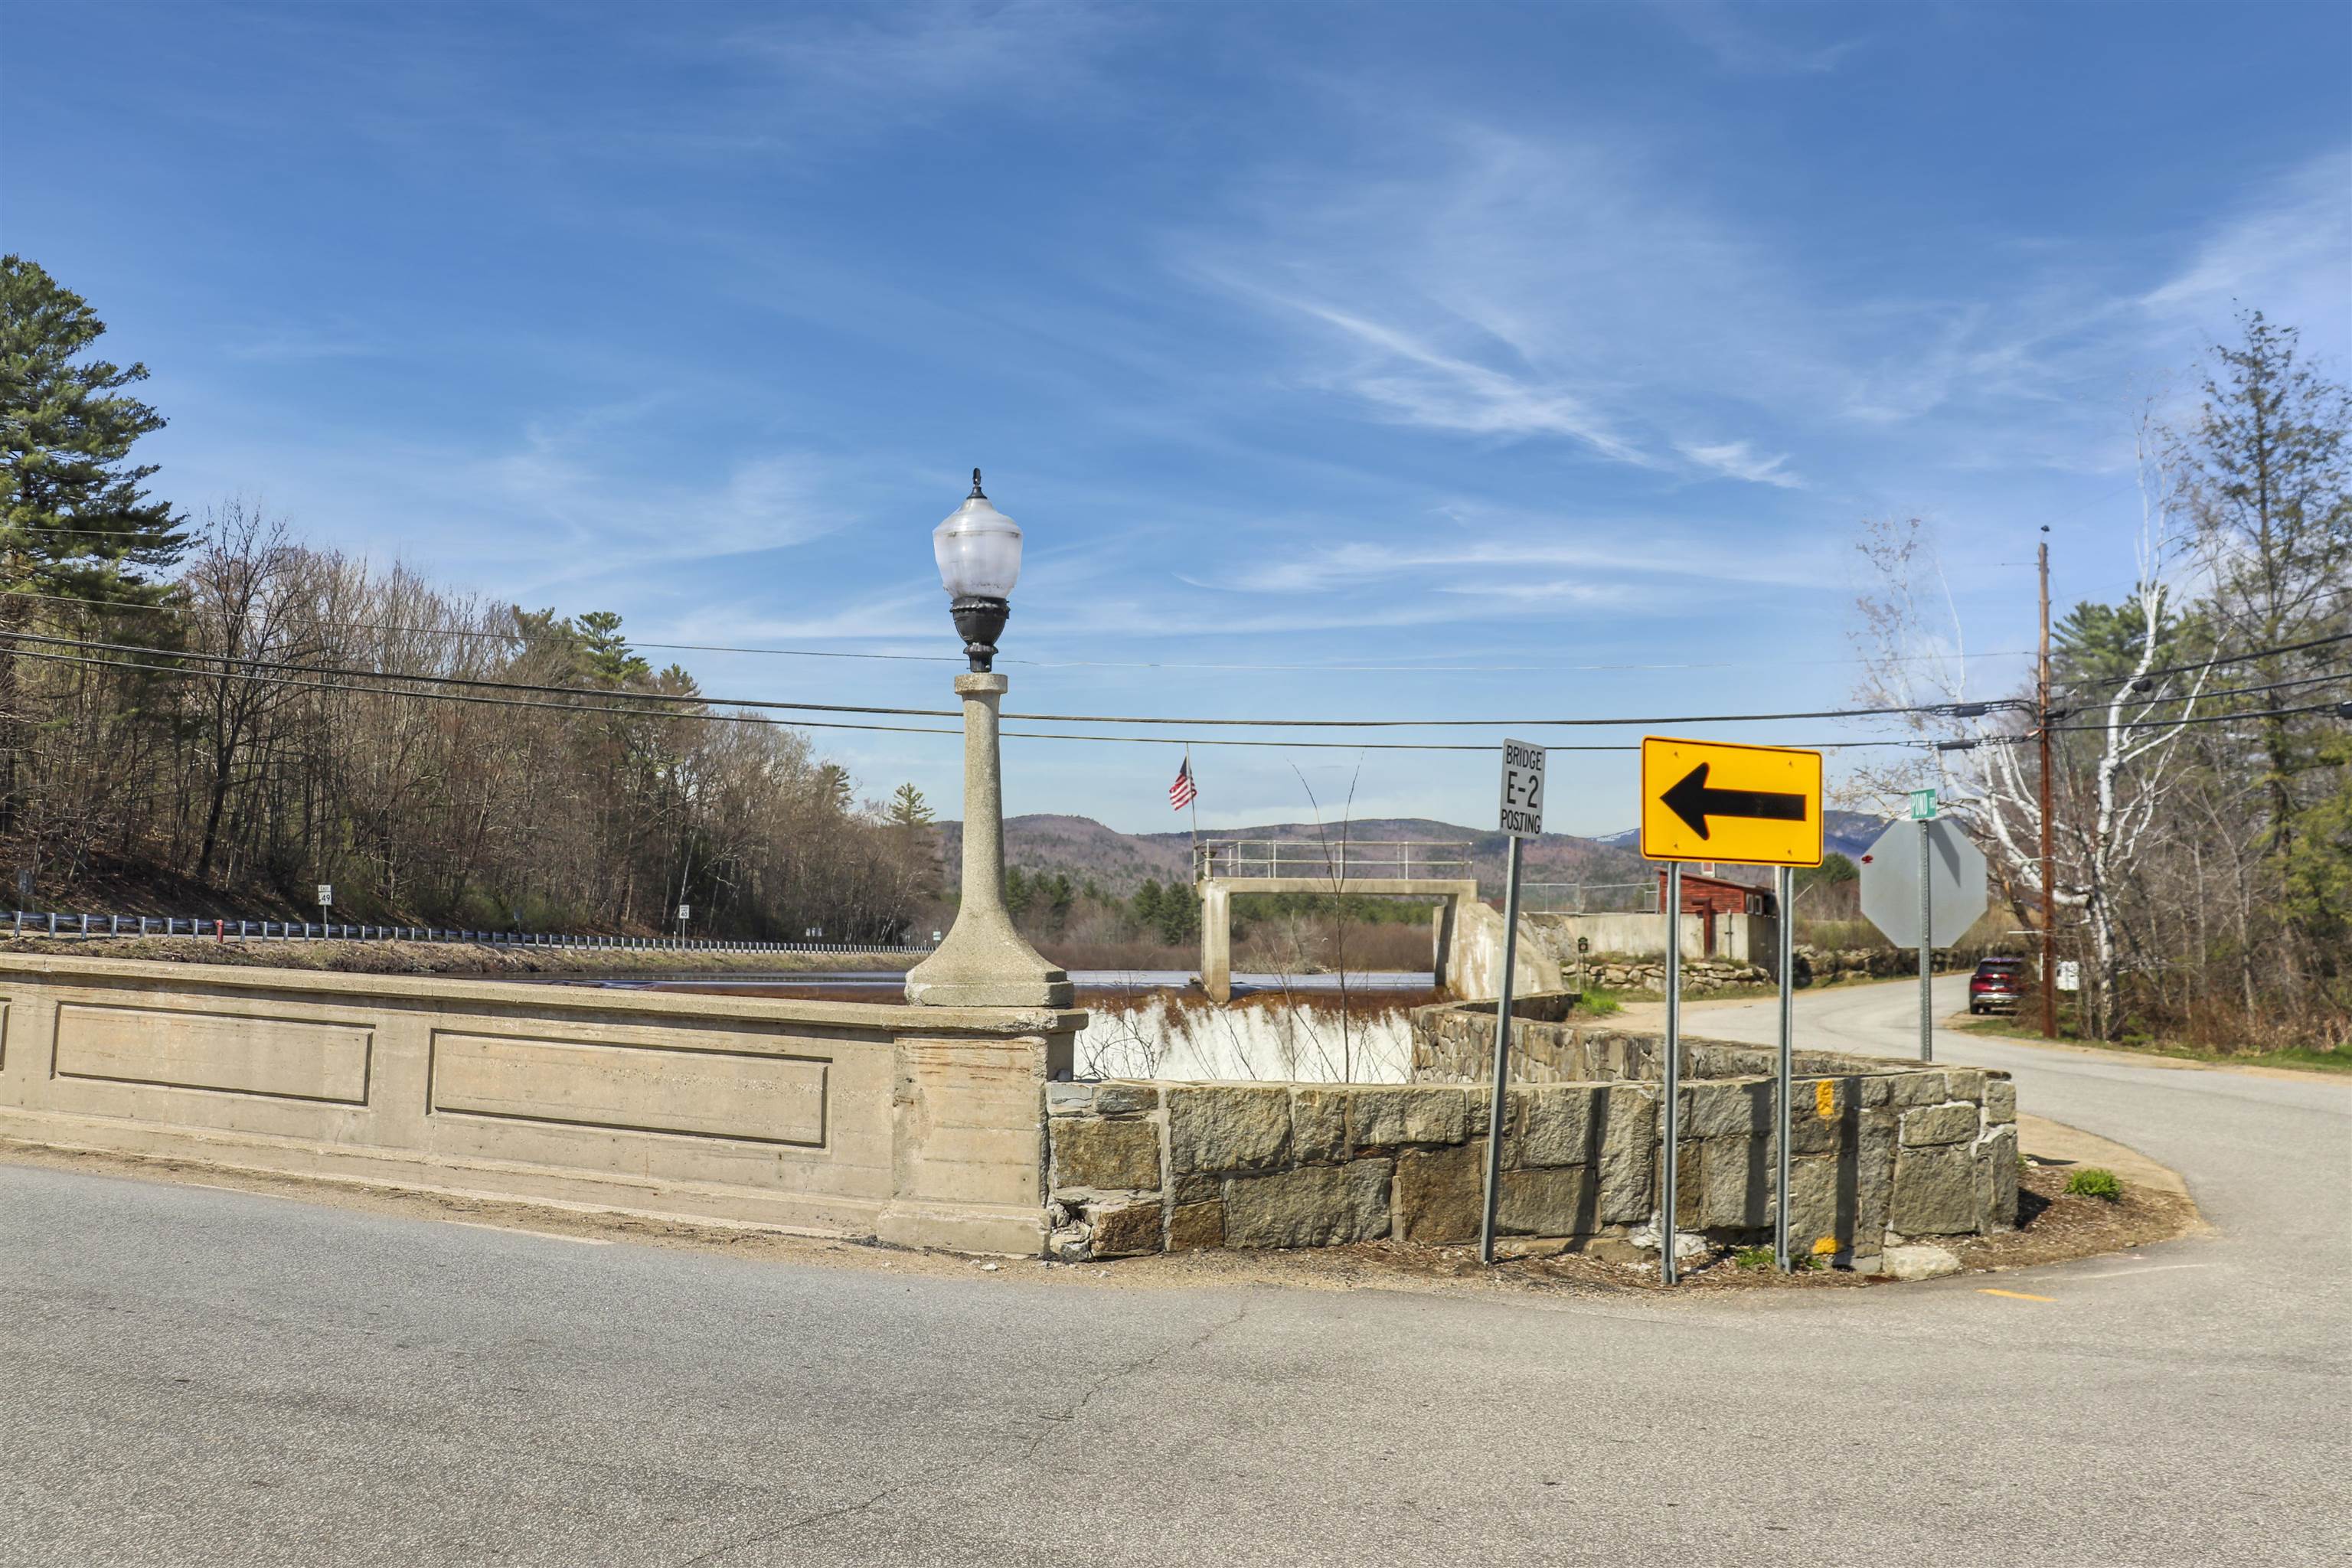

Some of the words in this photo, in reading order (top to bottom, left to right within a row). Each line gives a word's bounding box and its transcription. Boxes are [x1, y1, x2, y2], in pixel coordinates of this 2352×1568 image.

[1506, 745, 1542, 771] BRIDGE
[1507, 770, 1538, 808] E-2
[1911, 792, 1928, 815] POND
[1501, 808, 1540, 835] POSTING
